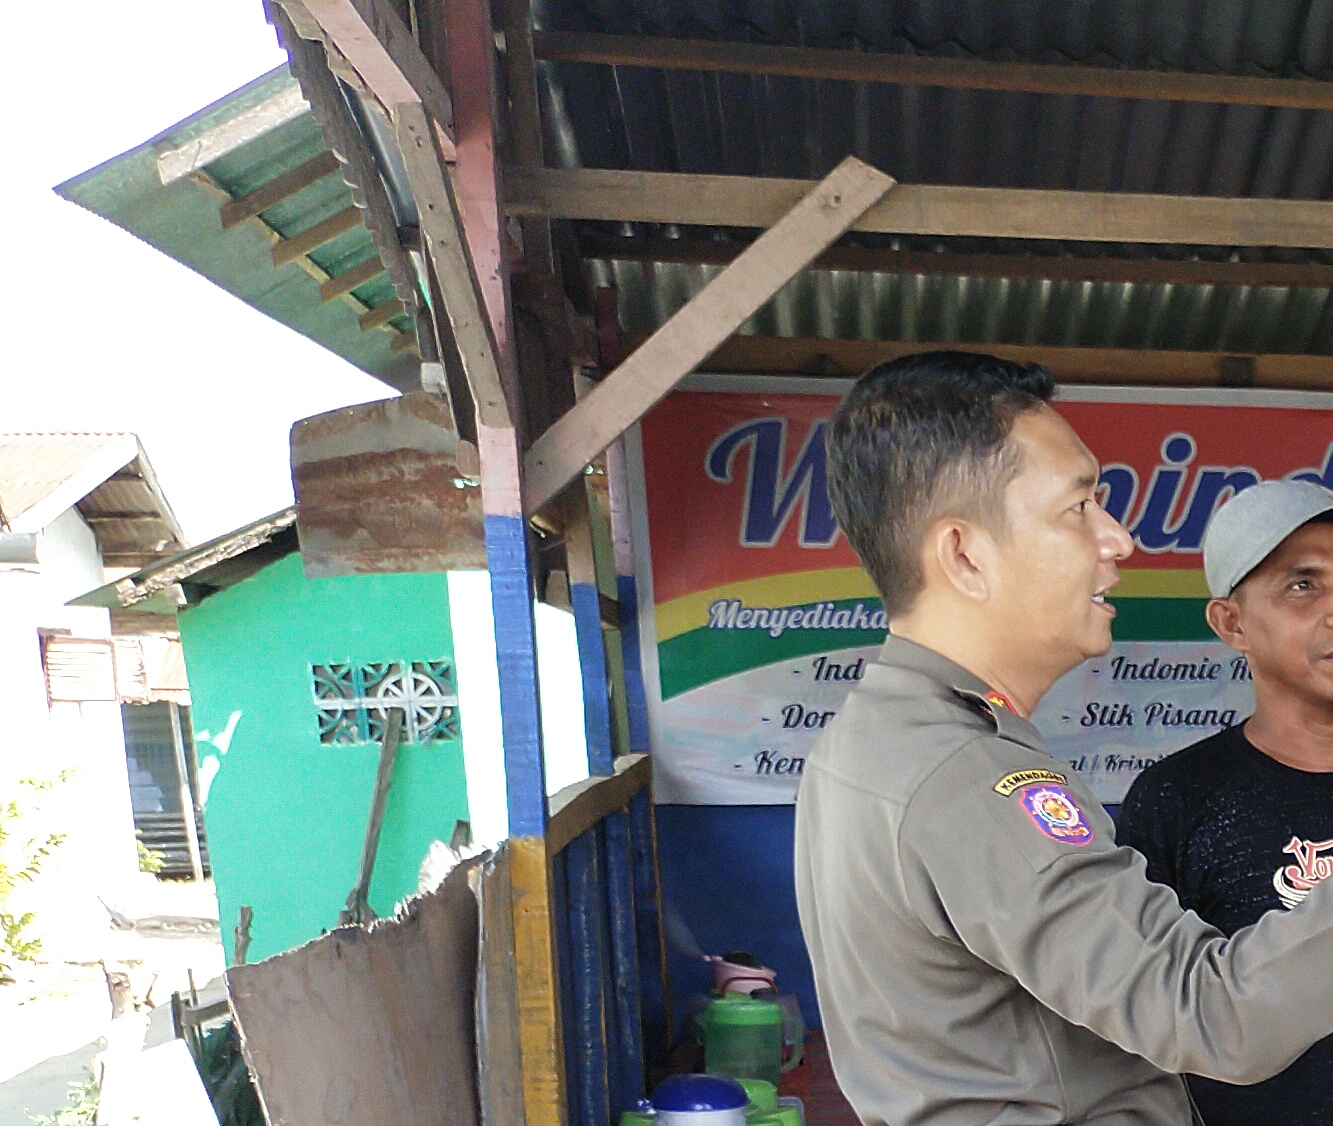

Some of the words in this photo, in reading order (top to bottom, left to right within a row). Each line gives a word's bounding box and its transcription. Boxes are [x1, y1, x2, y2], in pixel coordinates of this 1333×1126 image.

[1111, 656, 1222, 680] Indomie
[1081, 702, 1135, 727] Stik
[1144, 702, 1239, 731] Pisang
[1105, 754, 1169, 773] Krisp
